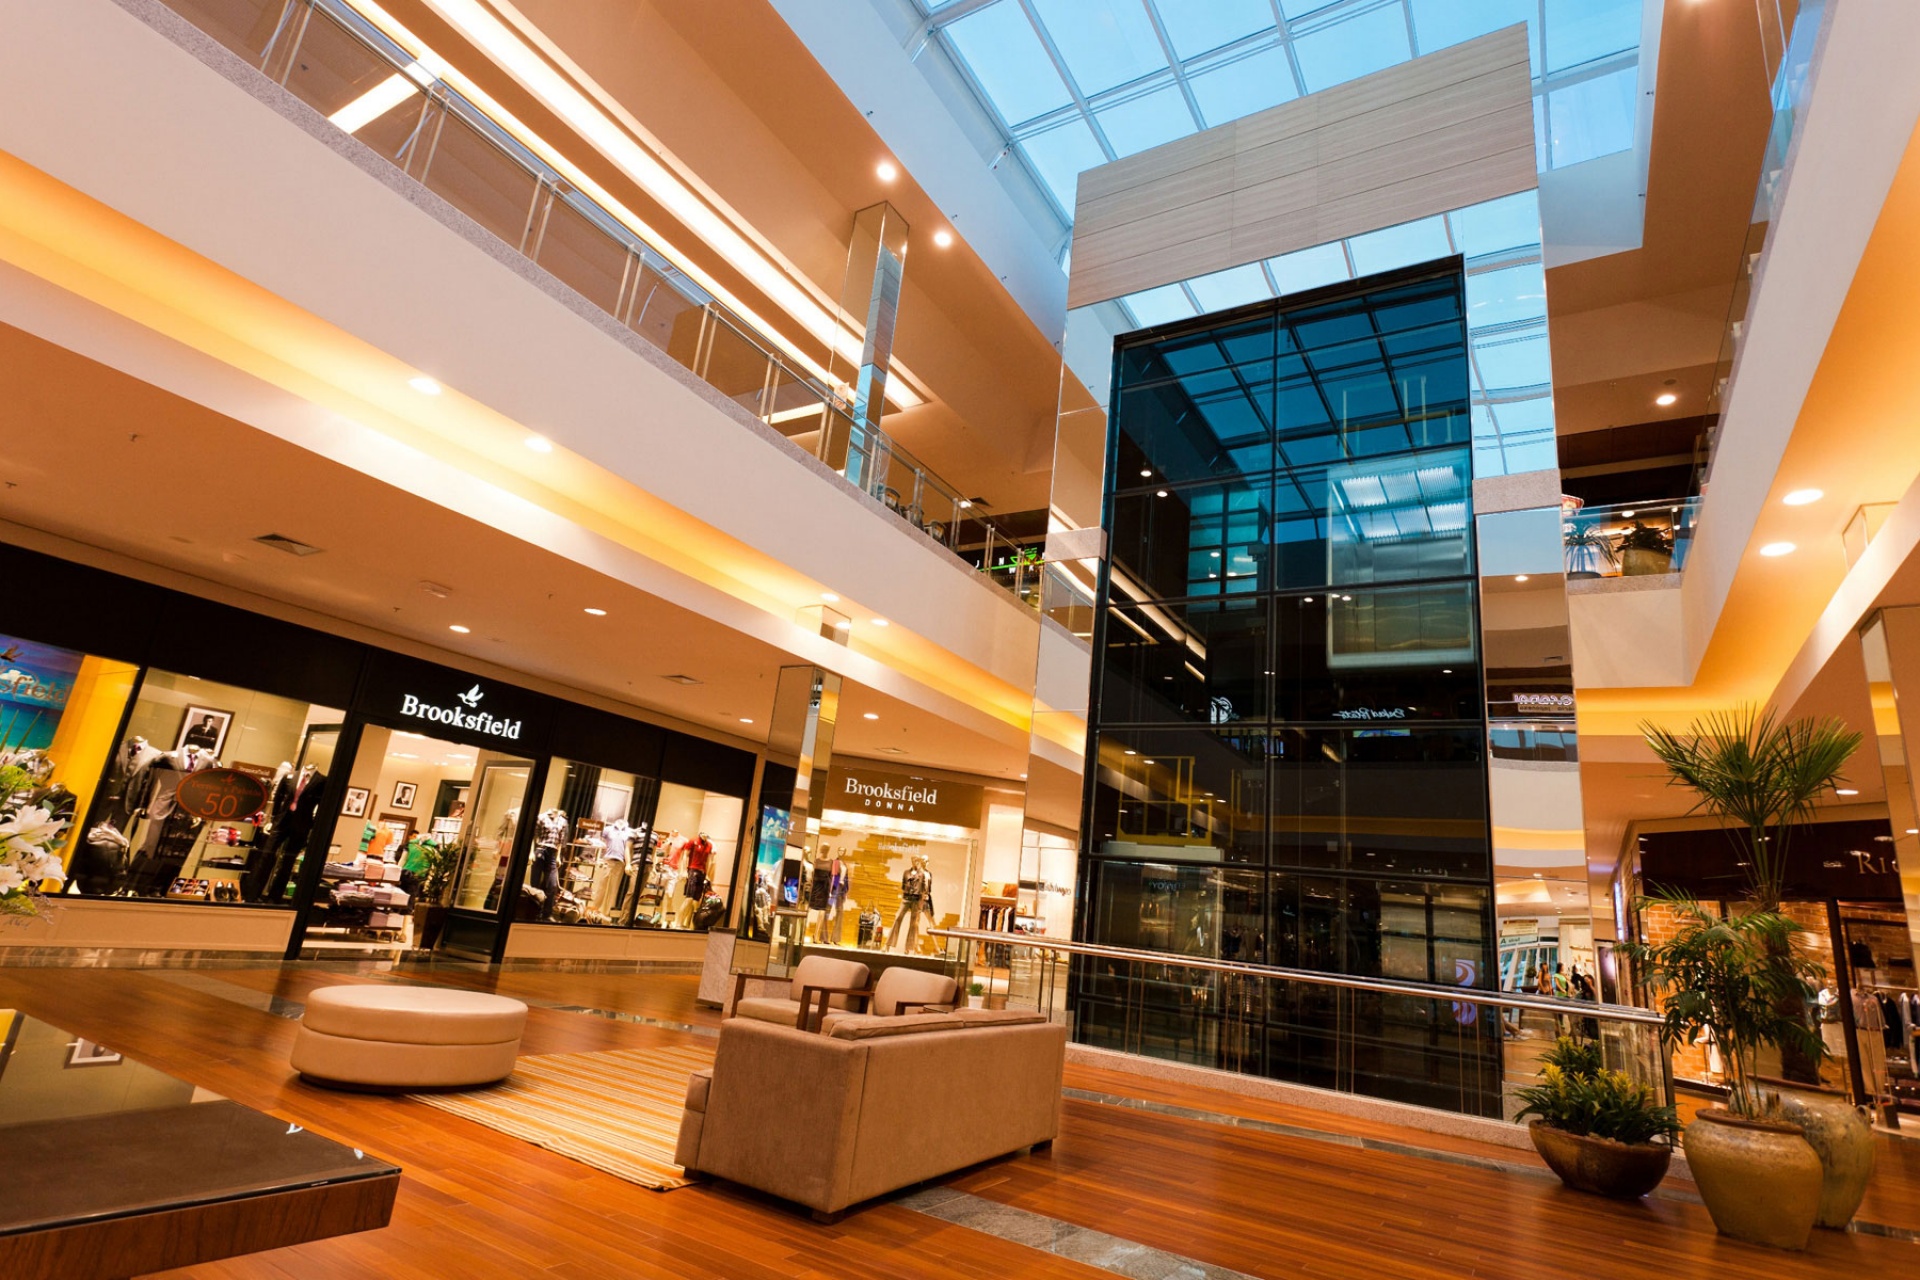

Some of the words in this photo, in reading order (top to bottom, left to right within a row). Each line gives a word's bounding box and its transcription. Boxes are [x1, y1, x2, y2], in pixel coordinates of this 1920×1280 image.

[1008, 565, 1034, 574] WK
[400, 694, 521, 739] Brooksfield
[845, 777, 938, 805] Brooksfield
[200, 793, 238, 817] 50
[864, 799, 914, 812] DONNA
